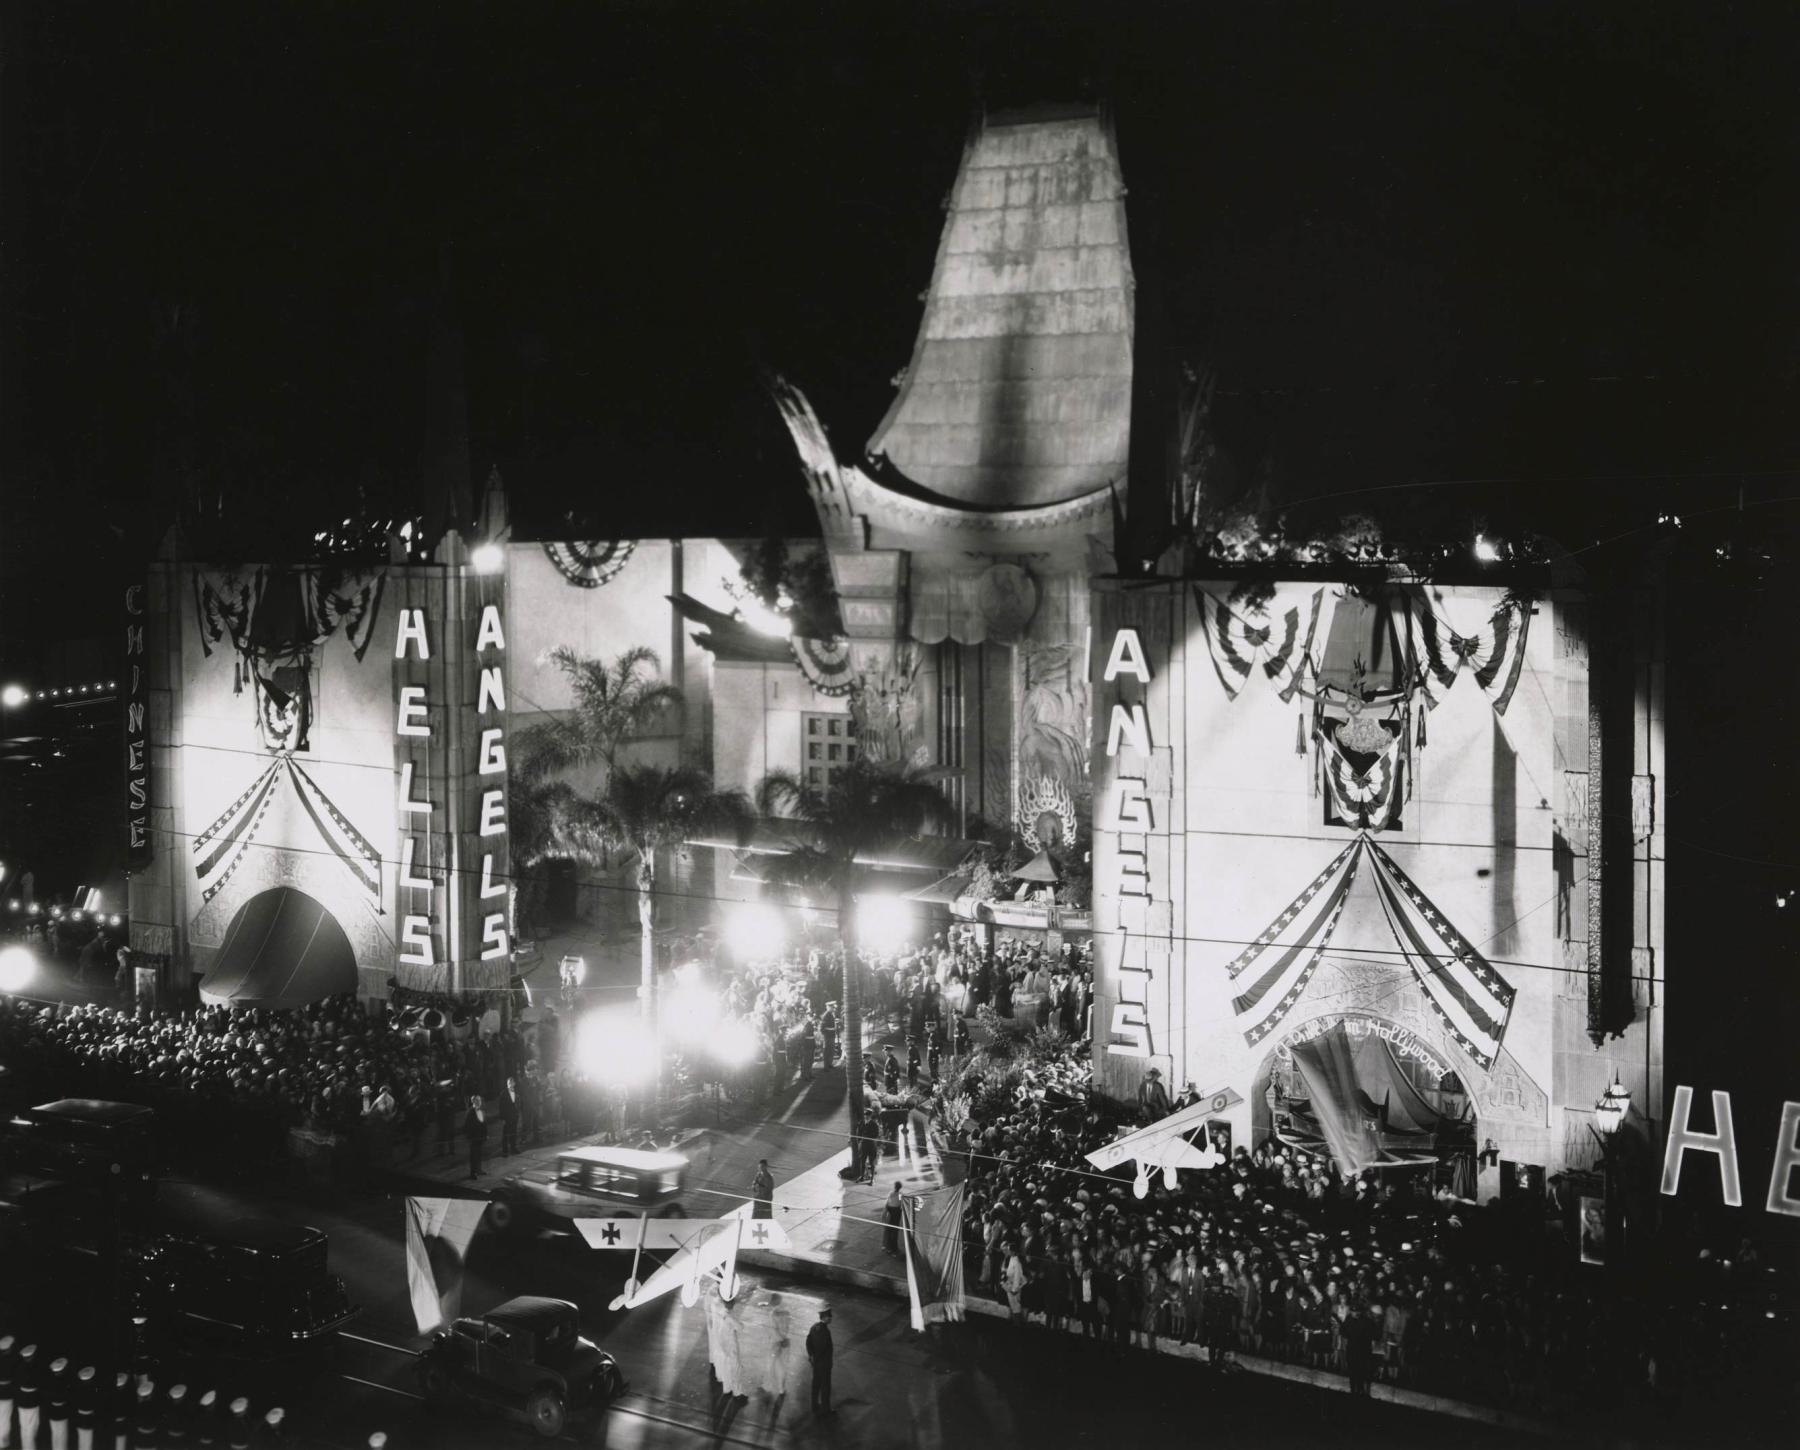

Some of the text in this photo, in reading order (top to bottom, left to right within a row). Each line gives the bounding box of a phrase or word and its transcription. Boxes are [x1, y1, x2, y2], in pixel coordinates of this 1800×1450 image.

[125, 584, 146, 848] CHINESE
[395, 608, 434, 966] HELLS
[476, 605, 508, 961] ANGELS
[1104, 628, 1153, 1058] ANGELS
[1366, 1018, 1453, 1082] Hollywood
